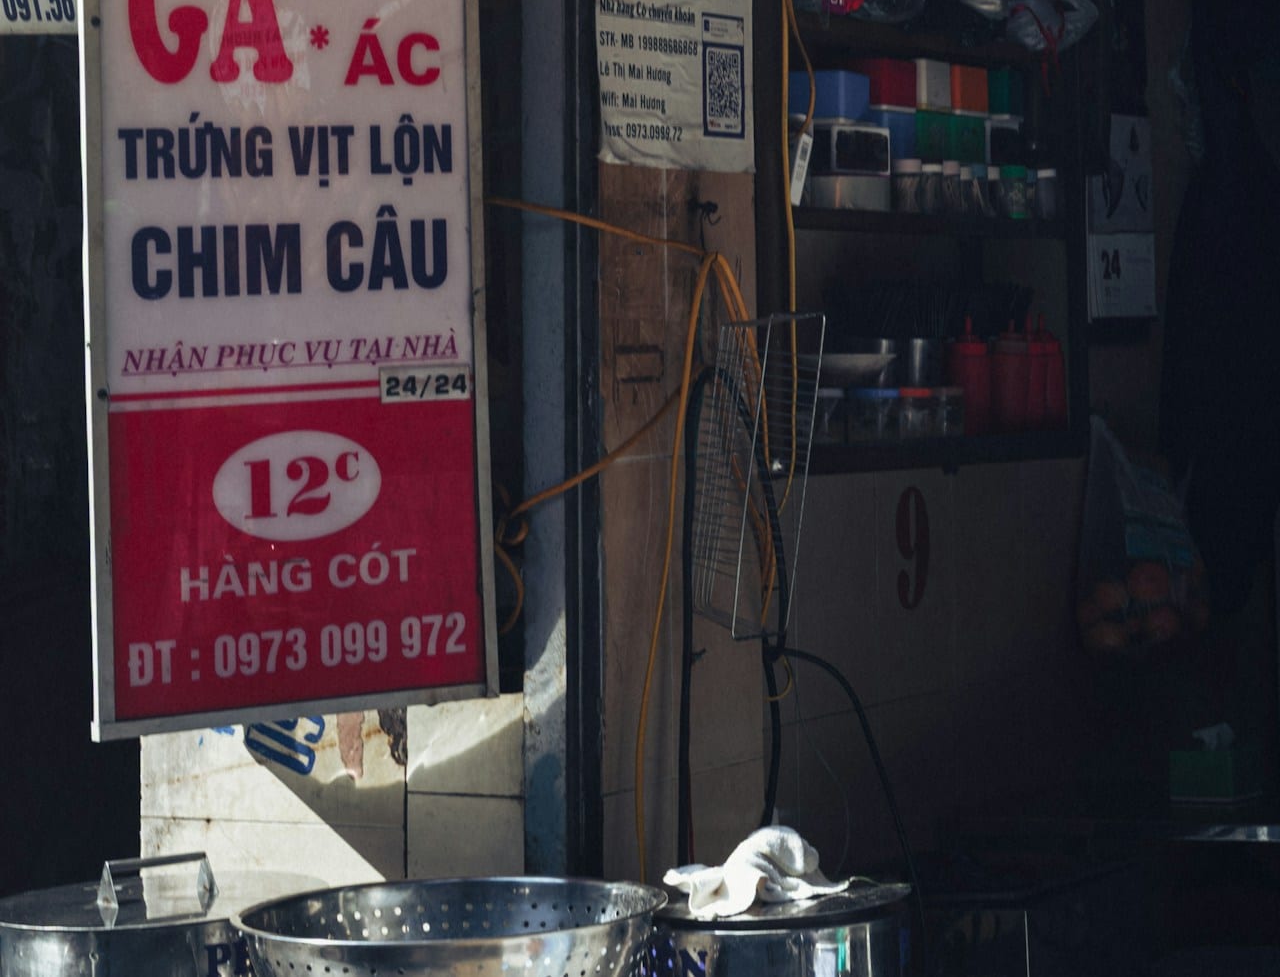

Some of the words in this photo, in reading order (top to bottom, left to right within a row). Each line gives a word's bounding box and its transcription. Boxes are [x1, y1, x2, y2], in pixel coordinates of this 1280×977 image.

[344, 18, 440, 86] ÁC
[621, 33, 633, 49] MB
[629, 64, 643, 80] Mai
[623, 92, 636, 108] Mai
[118, 112, 273, 180] TRỨNG
[288, 125, 354, 187] VỊT
[369, 113, 453, 186] LỘN
[131, 223, 302, 301] CHIM
[326, 204, 448, 293] CÂU
[123, 341, 208, 377] NHẬN
[216, 341, 296, 372] PHỤC
[304, 340, 340, 369] VỤ
[350, 337, 393, 365] TẠI
[401, 328, 458, 359] NHÀ
[385, 373, 467, 398] 24/24
[180, 552, 312, 602] HÀNG
[328, 542, 417, 589] CÓT
[128, 639, 176, 687] ĐT
[214, 628, 307, 678] 0973
[320, 619, 387, 667] 099
[400, 612, 466, 659] 972
